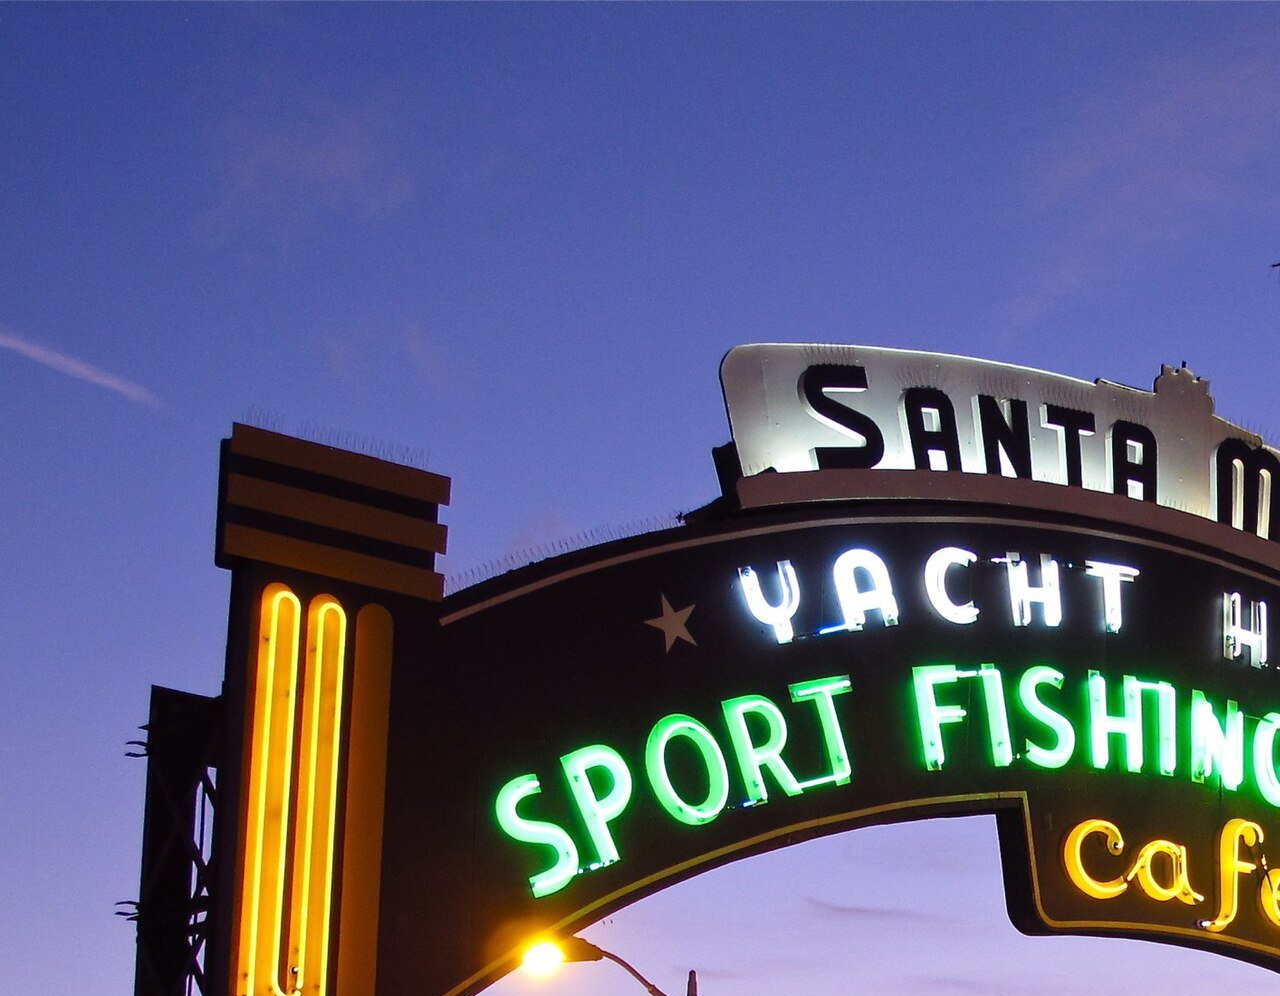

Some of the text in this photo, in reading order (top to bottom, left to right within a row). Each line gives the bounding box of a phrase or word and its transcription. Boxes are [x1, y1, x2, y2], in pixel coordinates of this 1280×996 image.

[799, 363, 1158, 503] SANTA
[736, 545, 1141, 645] YACHT
[495, 674, 853, 899] SPORT
